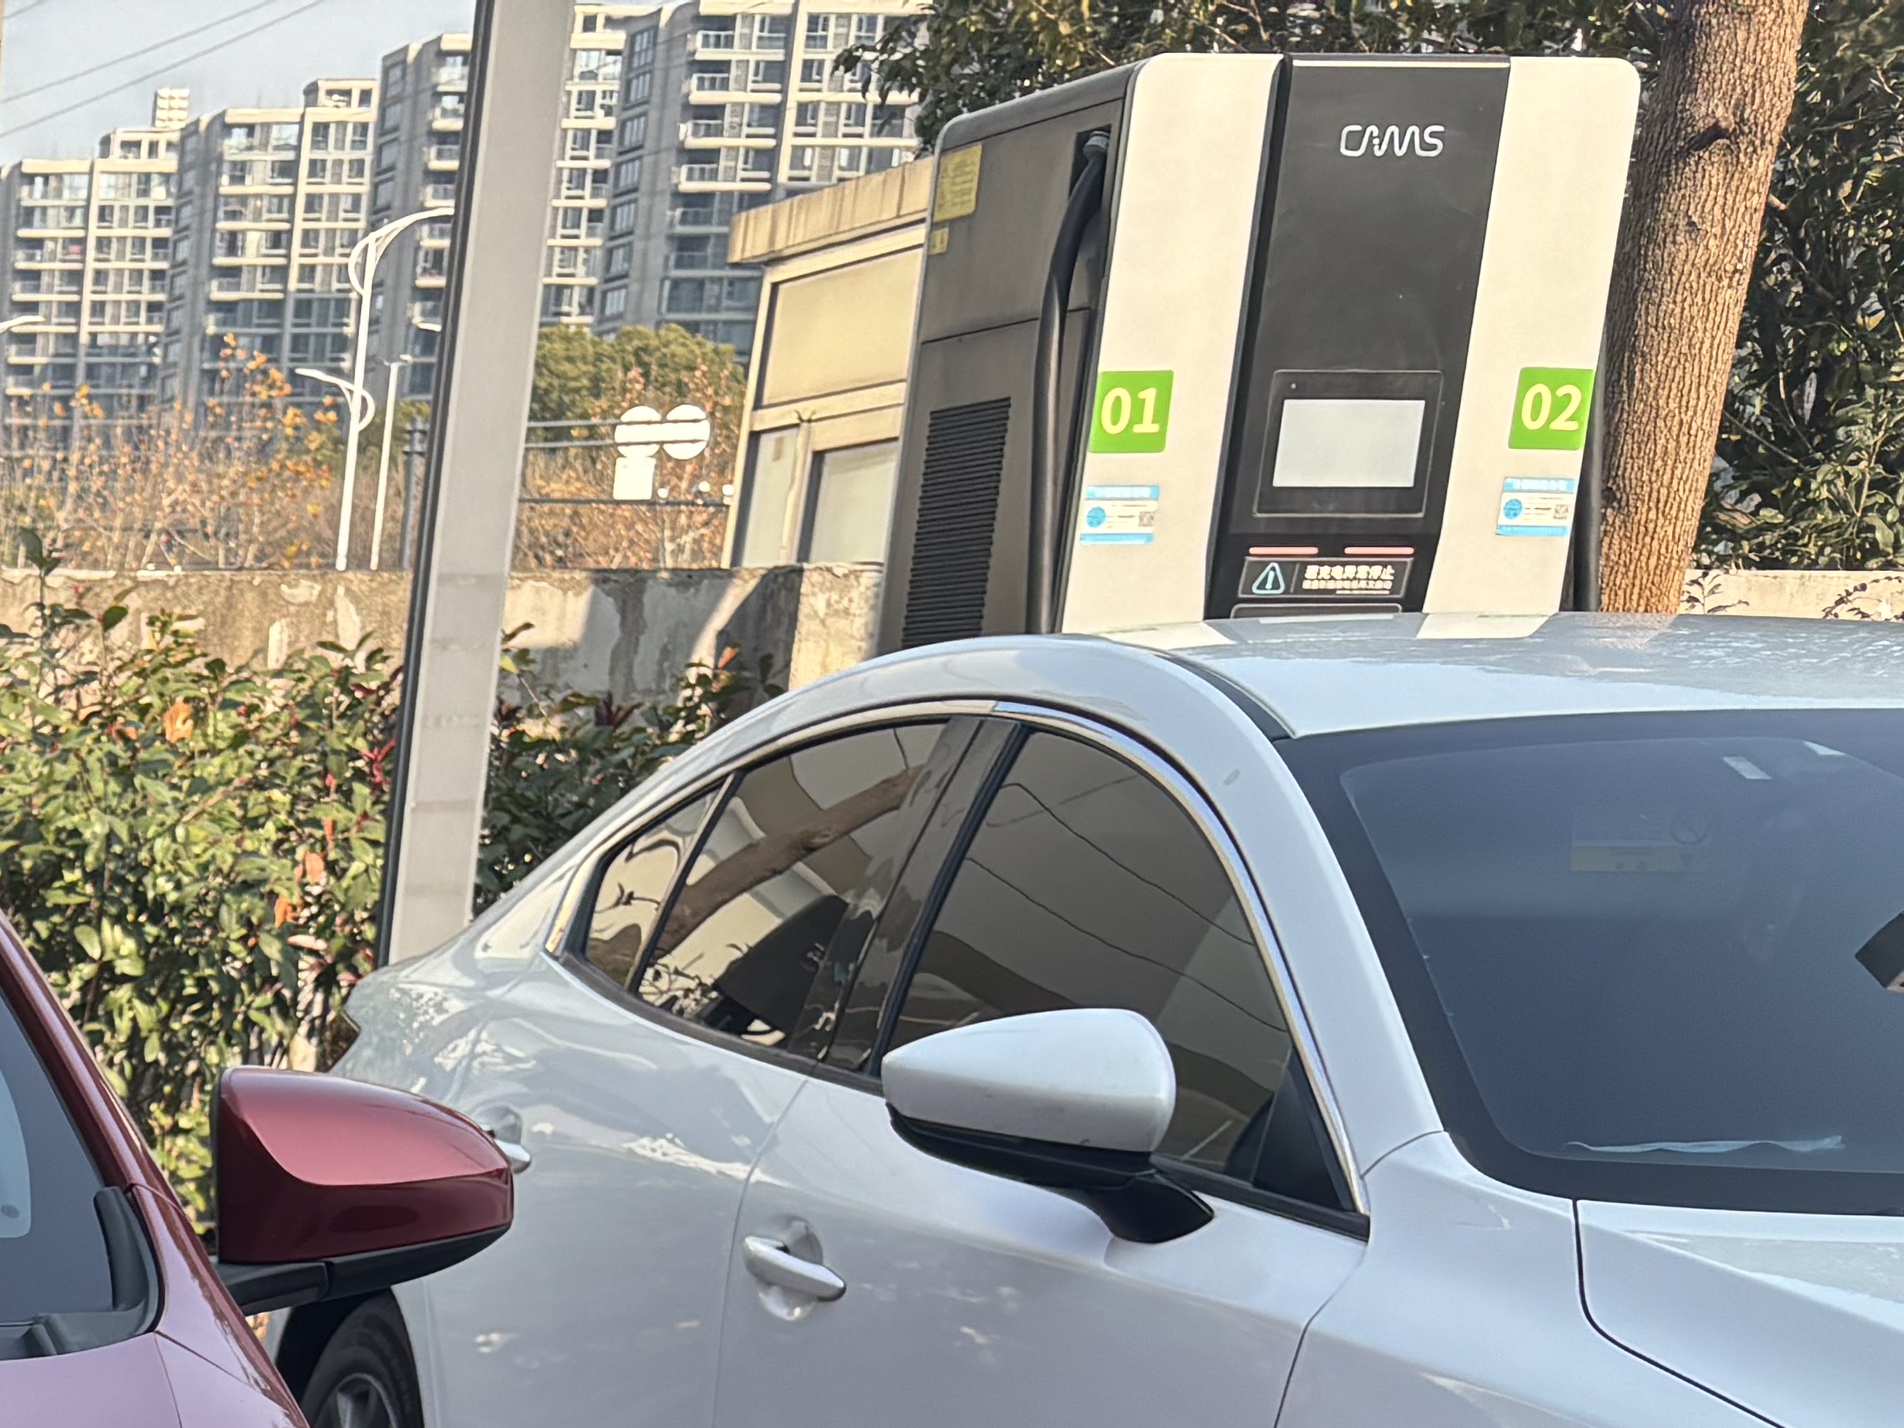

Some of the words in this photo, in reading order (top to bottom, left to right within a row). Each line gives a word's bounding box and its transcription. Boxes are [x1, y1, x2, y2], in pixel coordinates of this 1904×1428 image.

[1339, 124, 1445, 157] CAMS
[1101, 387, 1160, 435] 01
[1521, 383, 1582, 430] 02
